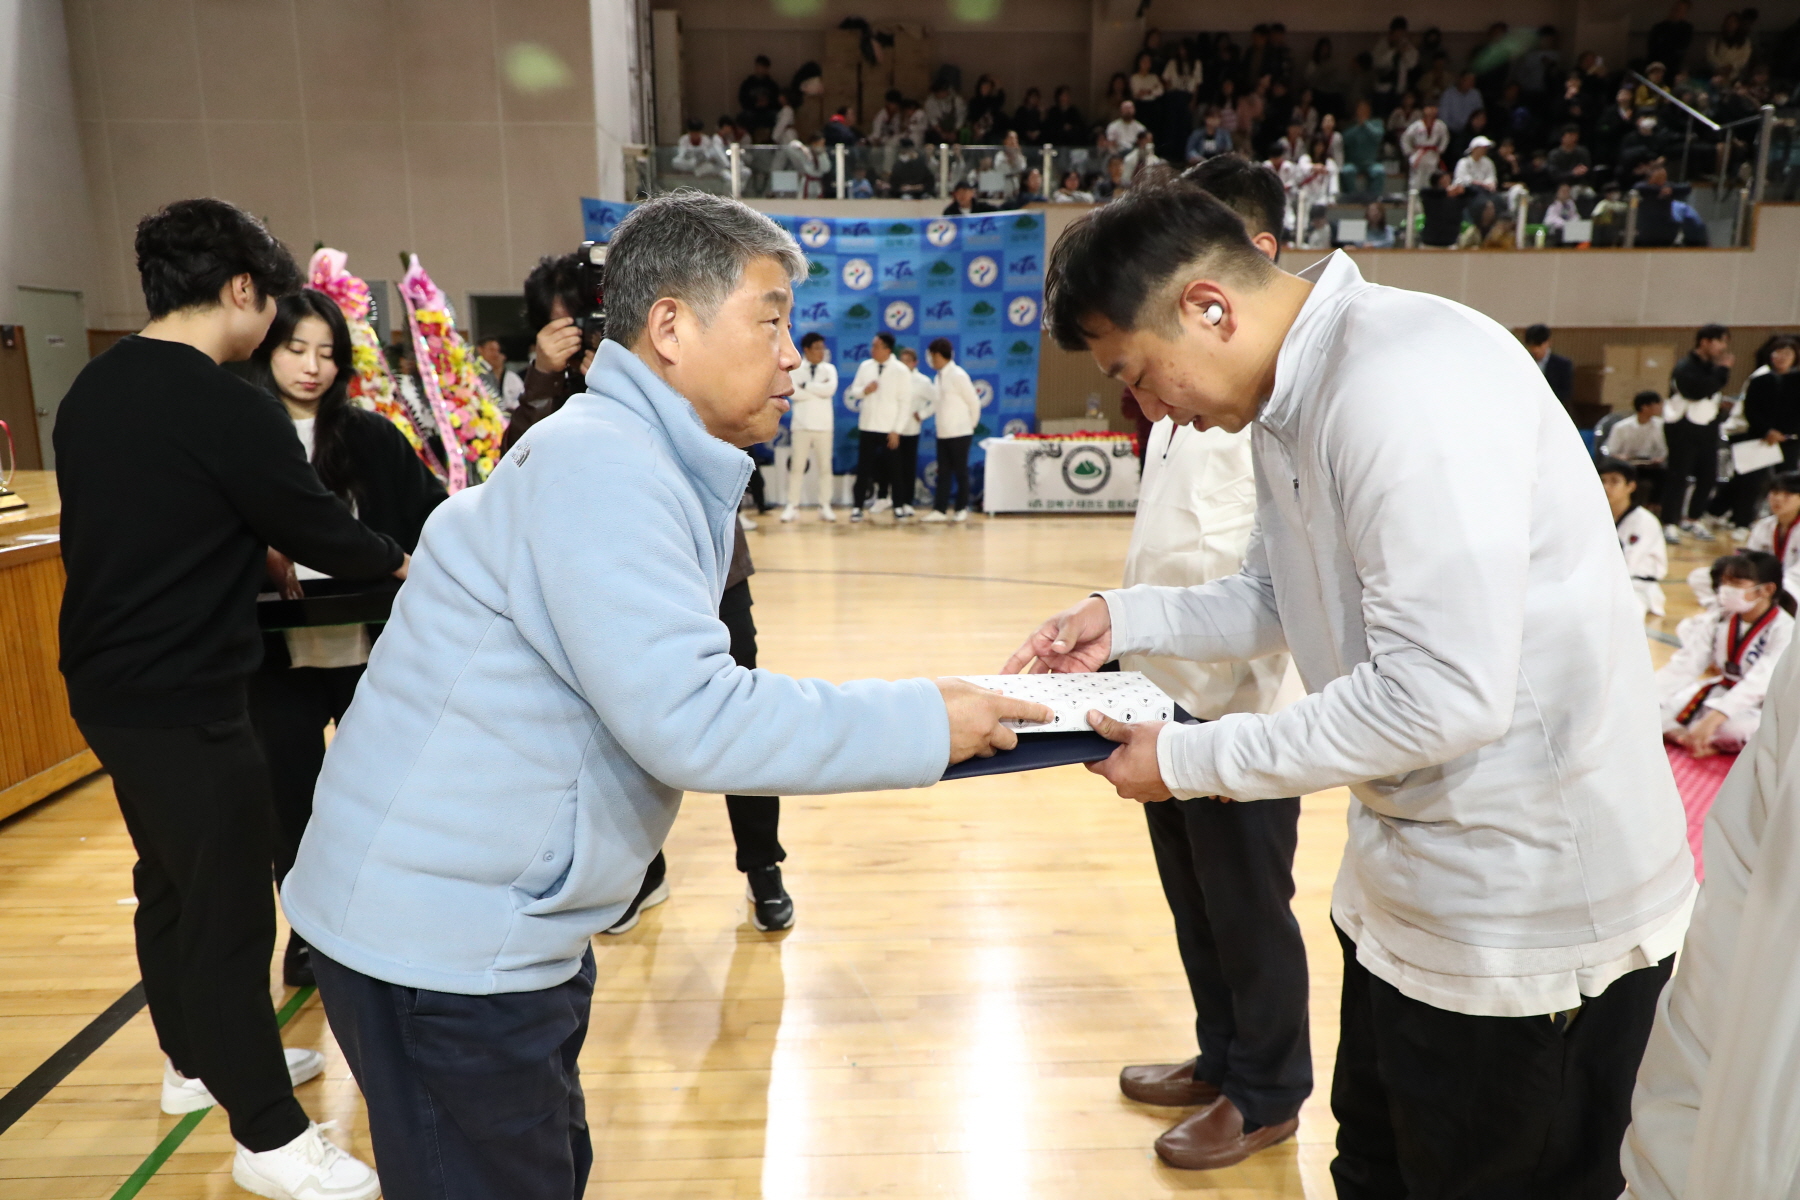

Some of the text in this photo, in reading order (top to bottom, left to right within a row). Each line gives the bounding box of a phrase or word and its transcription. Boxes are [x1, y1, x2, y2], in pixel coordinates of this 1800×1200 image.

[884, 260, 914, 279] KTA
[1009, 255, 1038, 275] KTA
[801, 301, 830, 320] KTA
[926, 300, 954, 319] KTA
[843, 343, 871, 361] KTA
[966, 339, 994, 358] KTA
[1005, 379, 1030, 397] KTA
